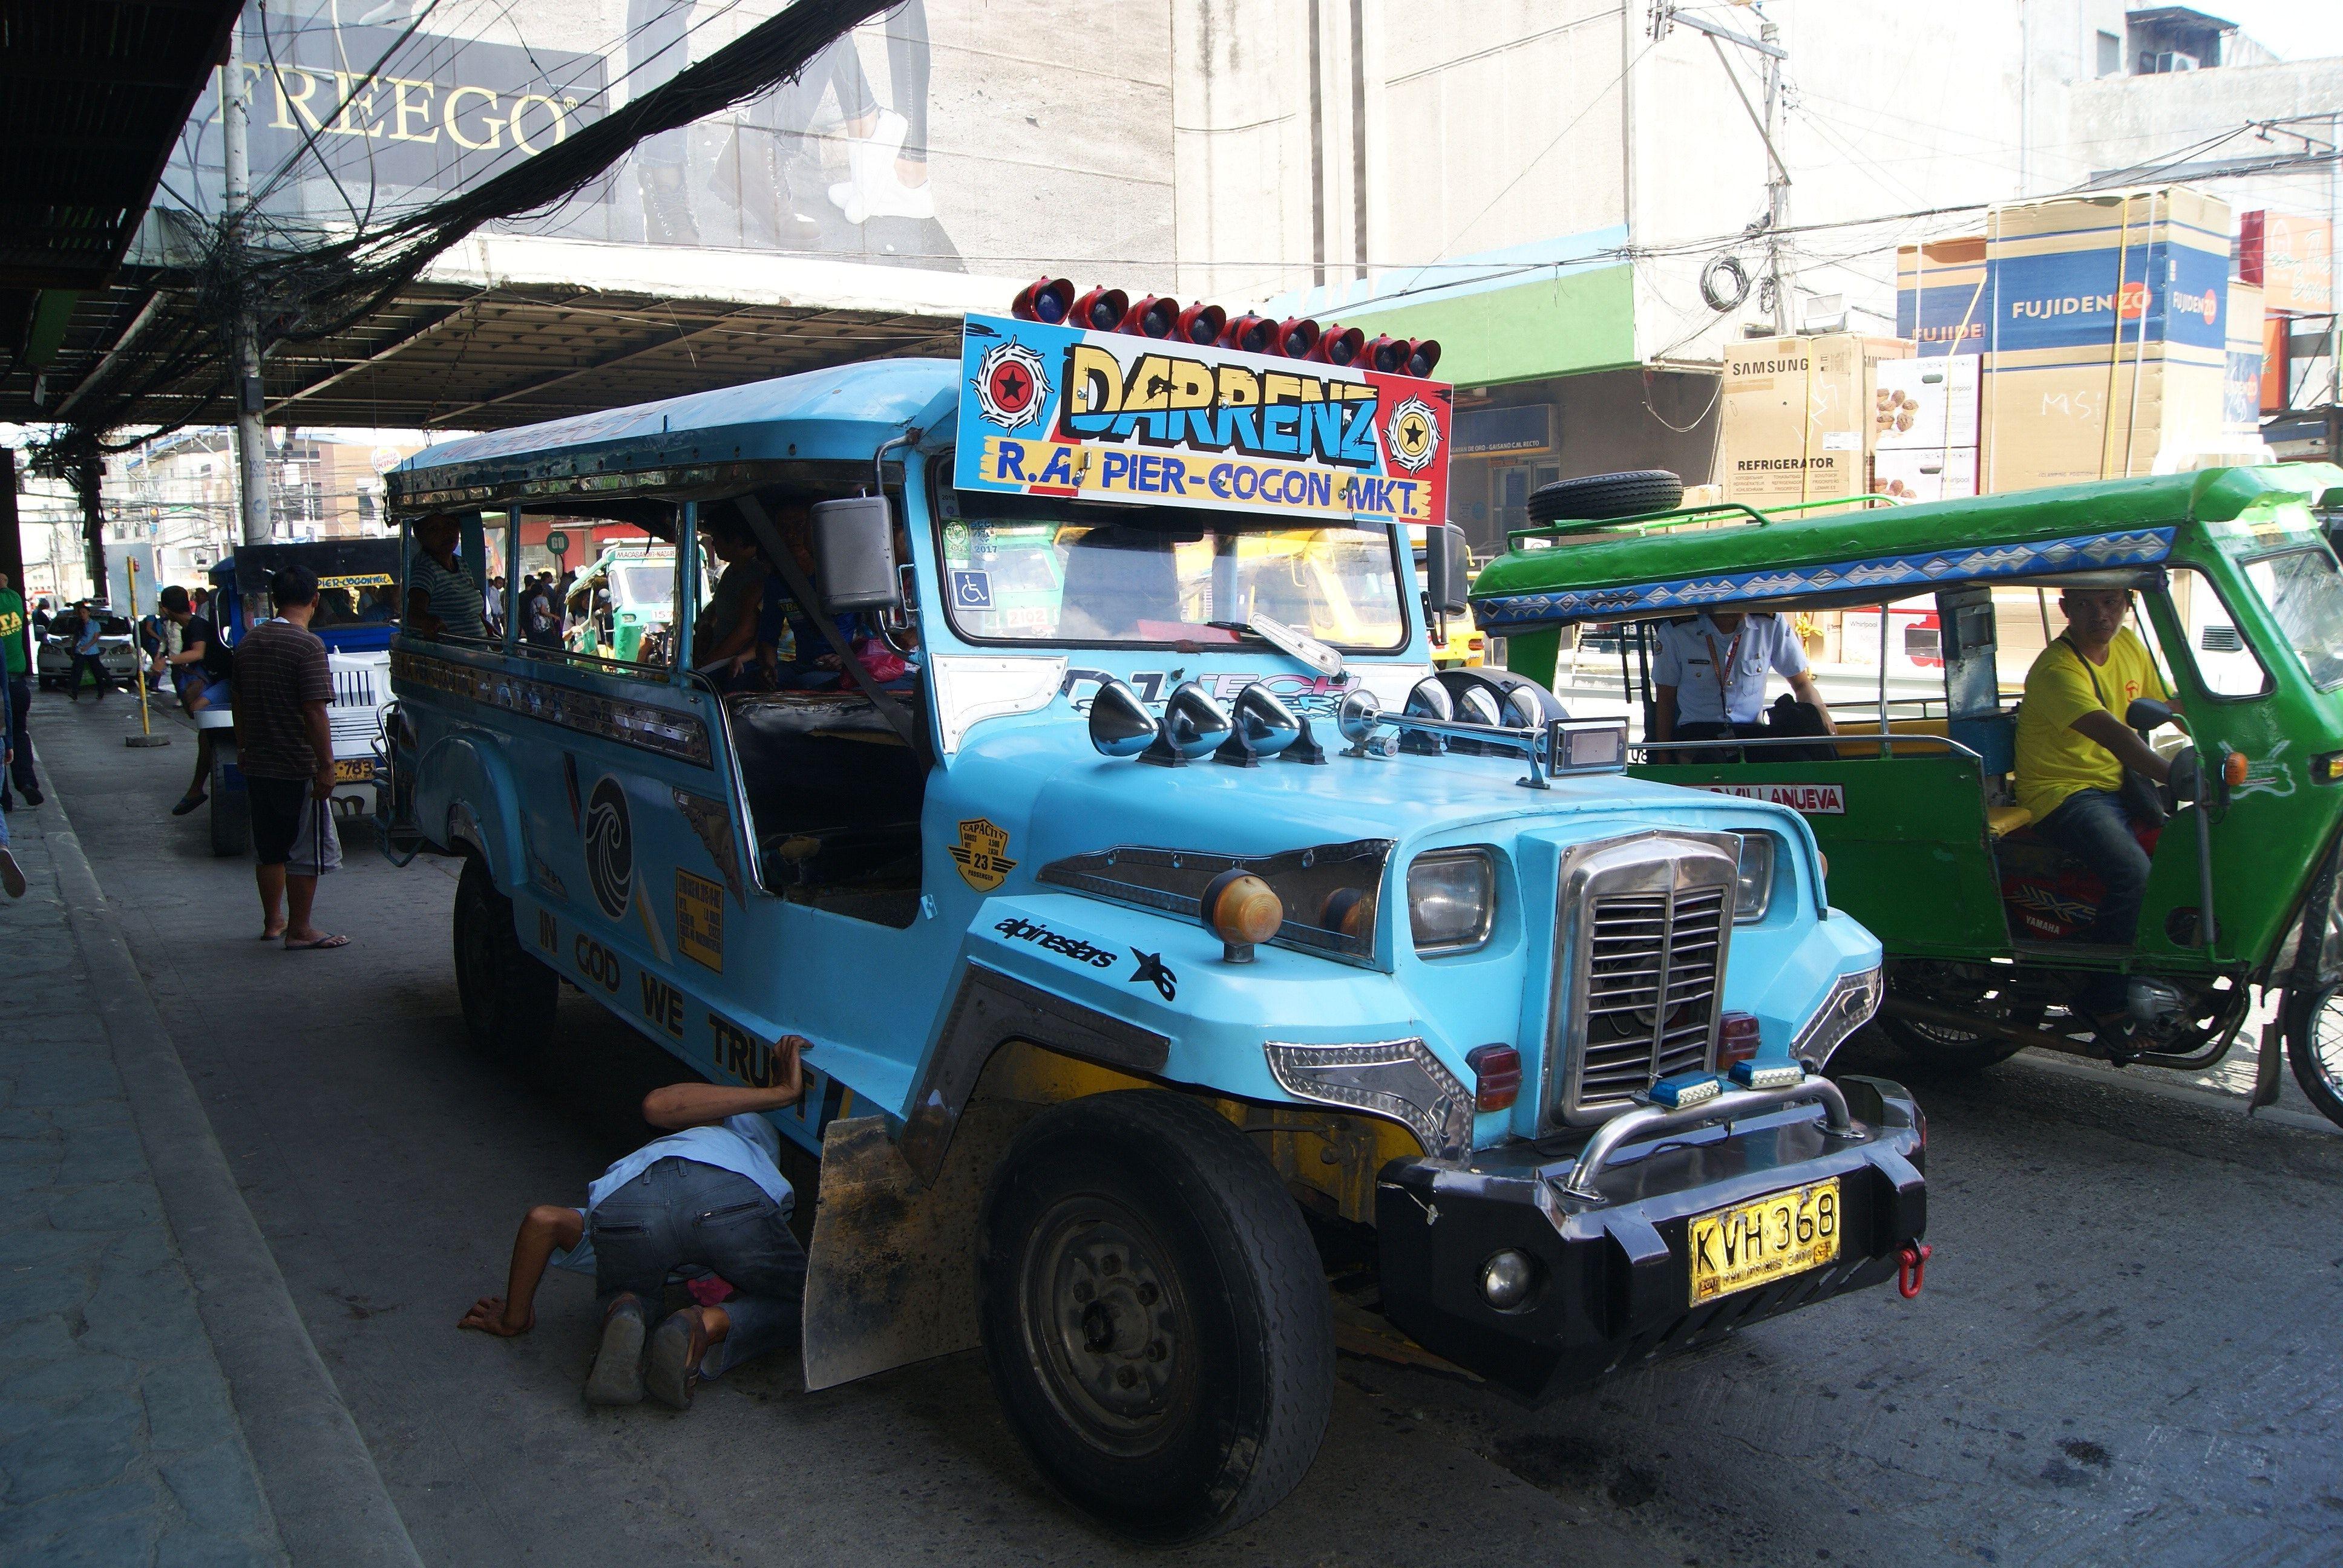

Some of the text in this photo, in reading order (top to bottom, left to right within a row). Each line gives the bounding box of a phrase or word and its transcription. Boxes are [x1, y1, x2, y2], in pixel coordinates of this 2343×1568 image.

[209, 62, 568, 156] FREEGO
[2013, 292, 2152, 319] FUJIDENZO
[1733, 358, 1808, 376] SAMSUNG
[1062, 345, 1377, 466] DARRENZ
[1738, 458, 1833, 471] REFRIGERATOR
[1347, 478, 1418, 515] MKT.
[1850, 621, 1878, 629] Whirlpool
[963, 823, 1004, 839] CAPACITY
[974, 853, 988, 870] 23
[2026, 915, 2060, 935] YAMAHA
[994, 918, 1118, 968] alpinestars
[539, 909, 816, 1122] IN GOD WE TRUT
[1772, 1193, 1833, 1253] 368
